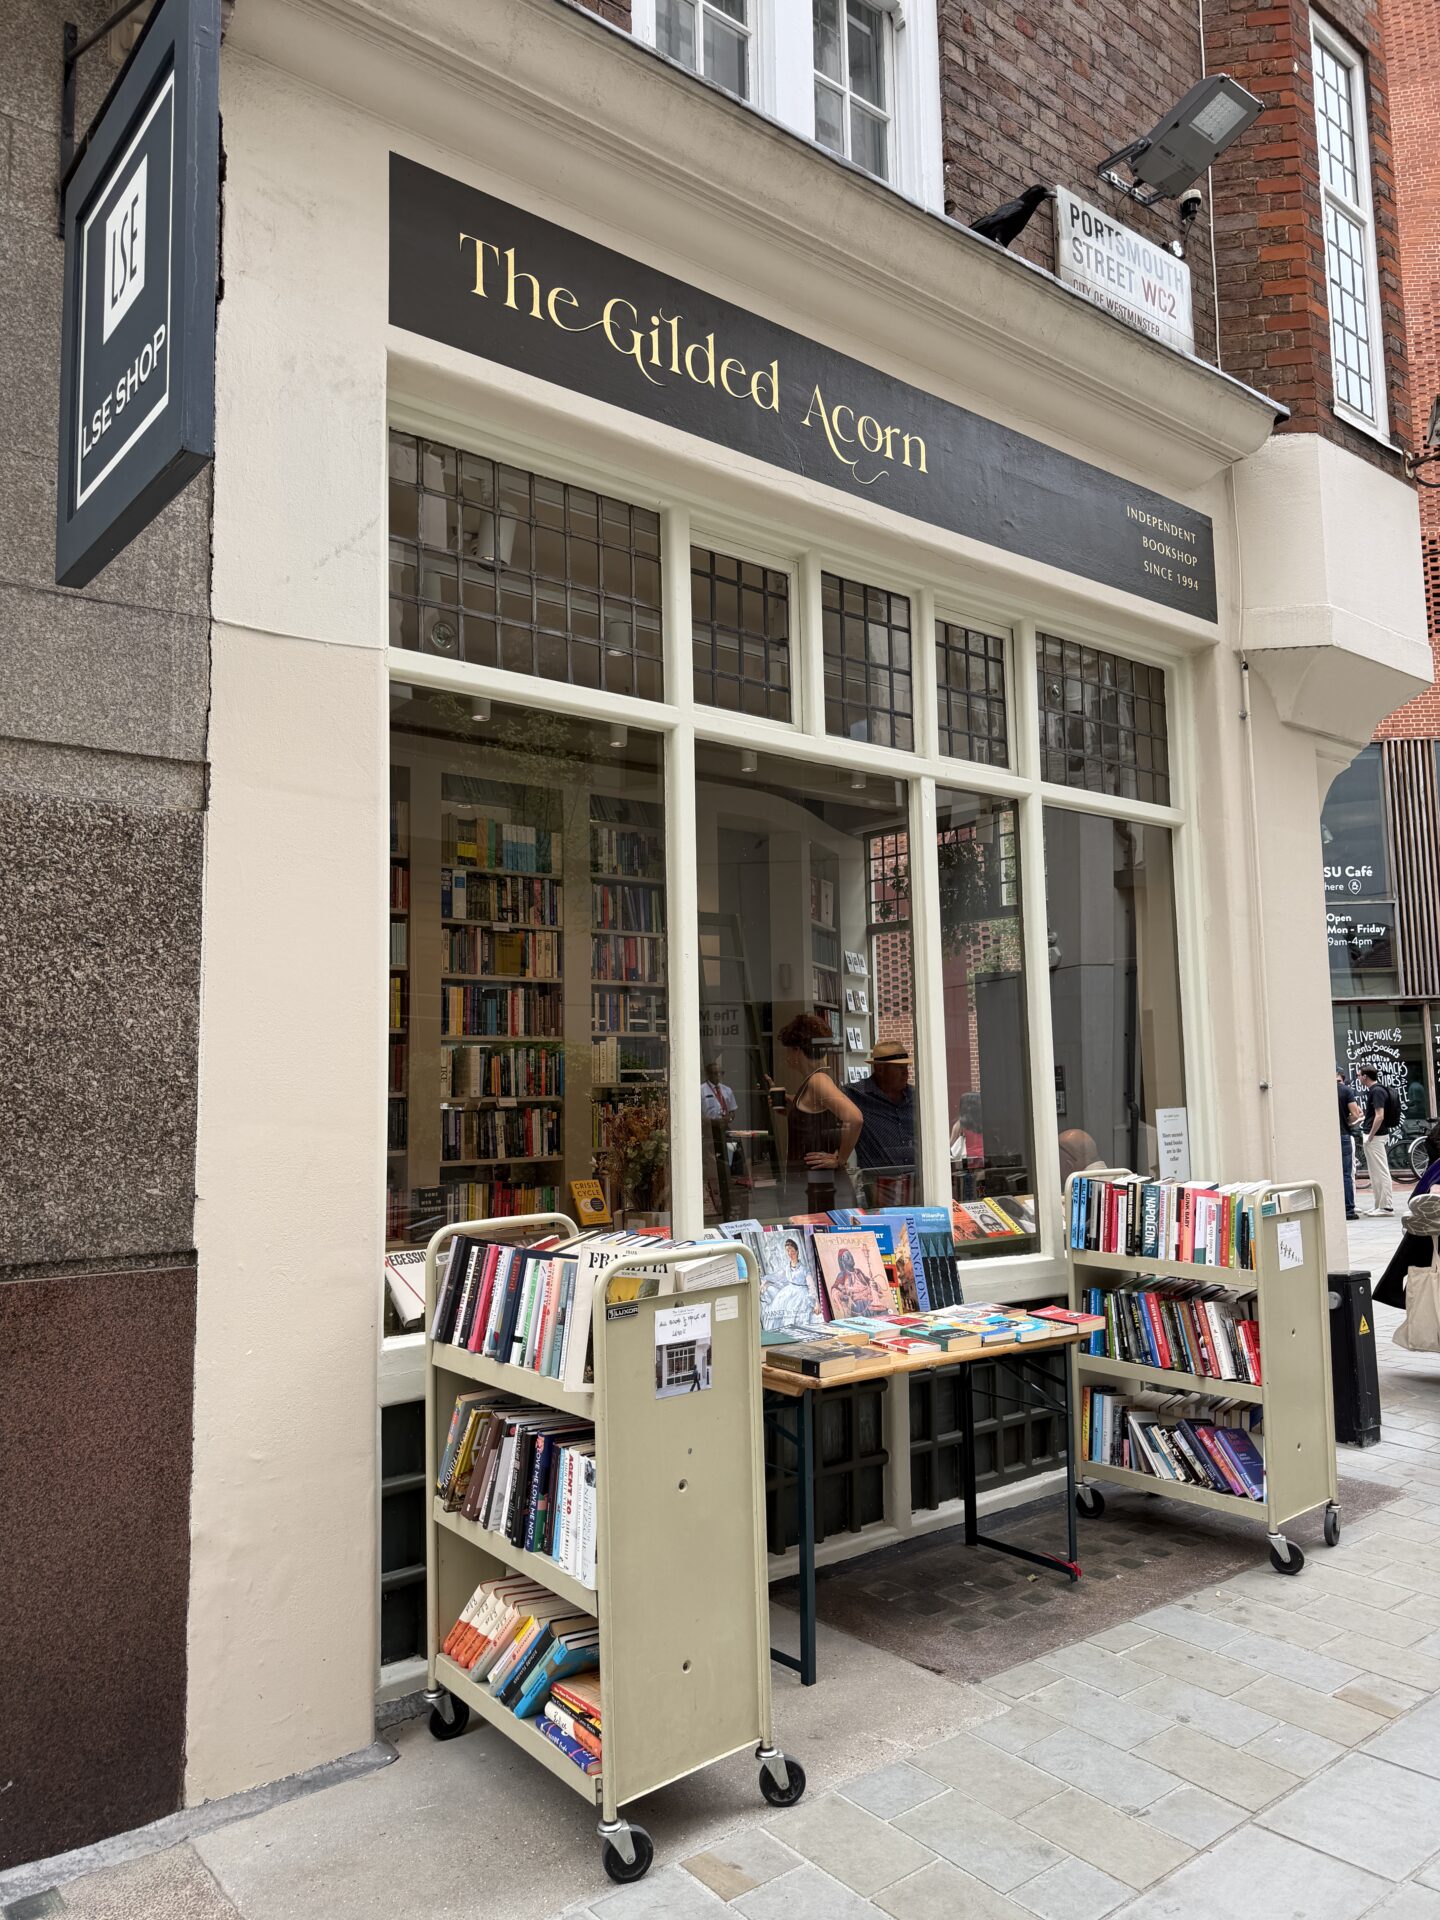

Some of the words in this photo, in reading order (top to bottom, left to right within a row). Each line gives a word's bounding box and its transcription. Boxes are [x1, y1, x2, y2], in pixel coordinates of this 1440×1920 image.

[110, 193, 139, 310] LSE
[1070, 202, 1184, 295] PORTSMOUTH
[1072, 236, 1135, 294] STREET
[1141, 276, 1177, 320] WC2
[1073, 279, 1091, 298] CITY
[1093, 290, 1104, 305] OF
[1106, 296, 1160, 337] WESTMINSTER
[459, 232, 600, 333] The
[602, 298, 780, 413] Gilded
[800, 384, 929, 485] Acorn
[82, 391, 112, 458] LSE
[115, 323, 166, 418] SHOP
[1126, 505, 1196, 545] INDEPENDENT
[1142, 535, 1198, 567] BOOKSHOP
[1143, 560, 1173, 581] SINCE
[1177, 573, 1199, 591] 1994
[1345, 865, 1373, 877] Café
[1324, 882, 1344, 891] here
[1326, 913, 1352, 925] Open
[1327, 925, 1348, 934] Mon
[1356, 924, 1386, 936] Friday
[1327, 937, 1373, 948] 9am-4pm
[575, 1181, 599, 1189] CRISIS
[577, 1189, 601, 1197] CYCLE
[1145, 1196, 1156, 1244] NAPOLEON
[466, 1262, 472, 1271] OF
[905, 1216, 928, 1300] BONINGTON
[614, 1306, 638, 1318] LUXOR
[765, 1309, 785, 1318] MANET
[536, 1447, 544, 1468] LOVE
[534, 1470, 541, 1482] ME
[566, 1454, 574, 1494] AGENT
[531, 1484, 539, 1506] LOVE
[530, 1507, 536, 1519] ME
[565, 1498, 571, 1515] ZO
[527, 1521, 535, 1540] NOT
